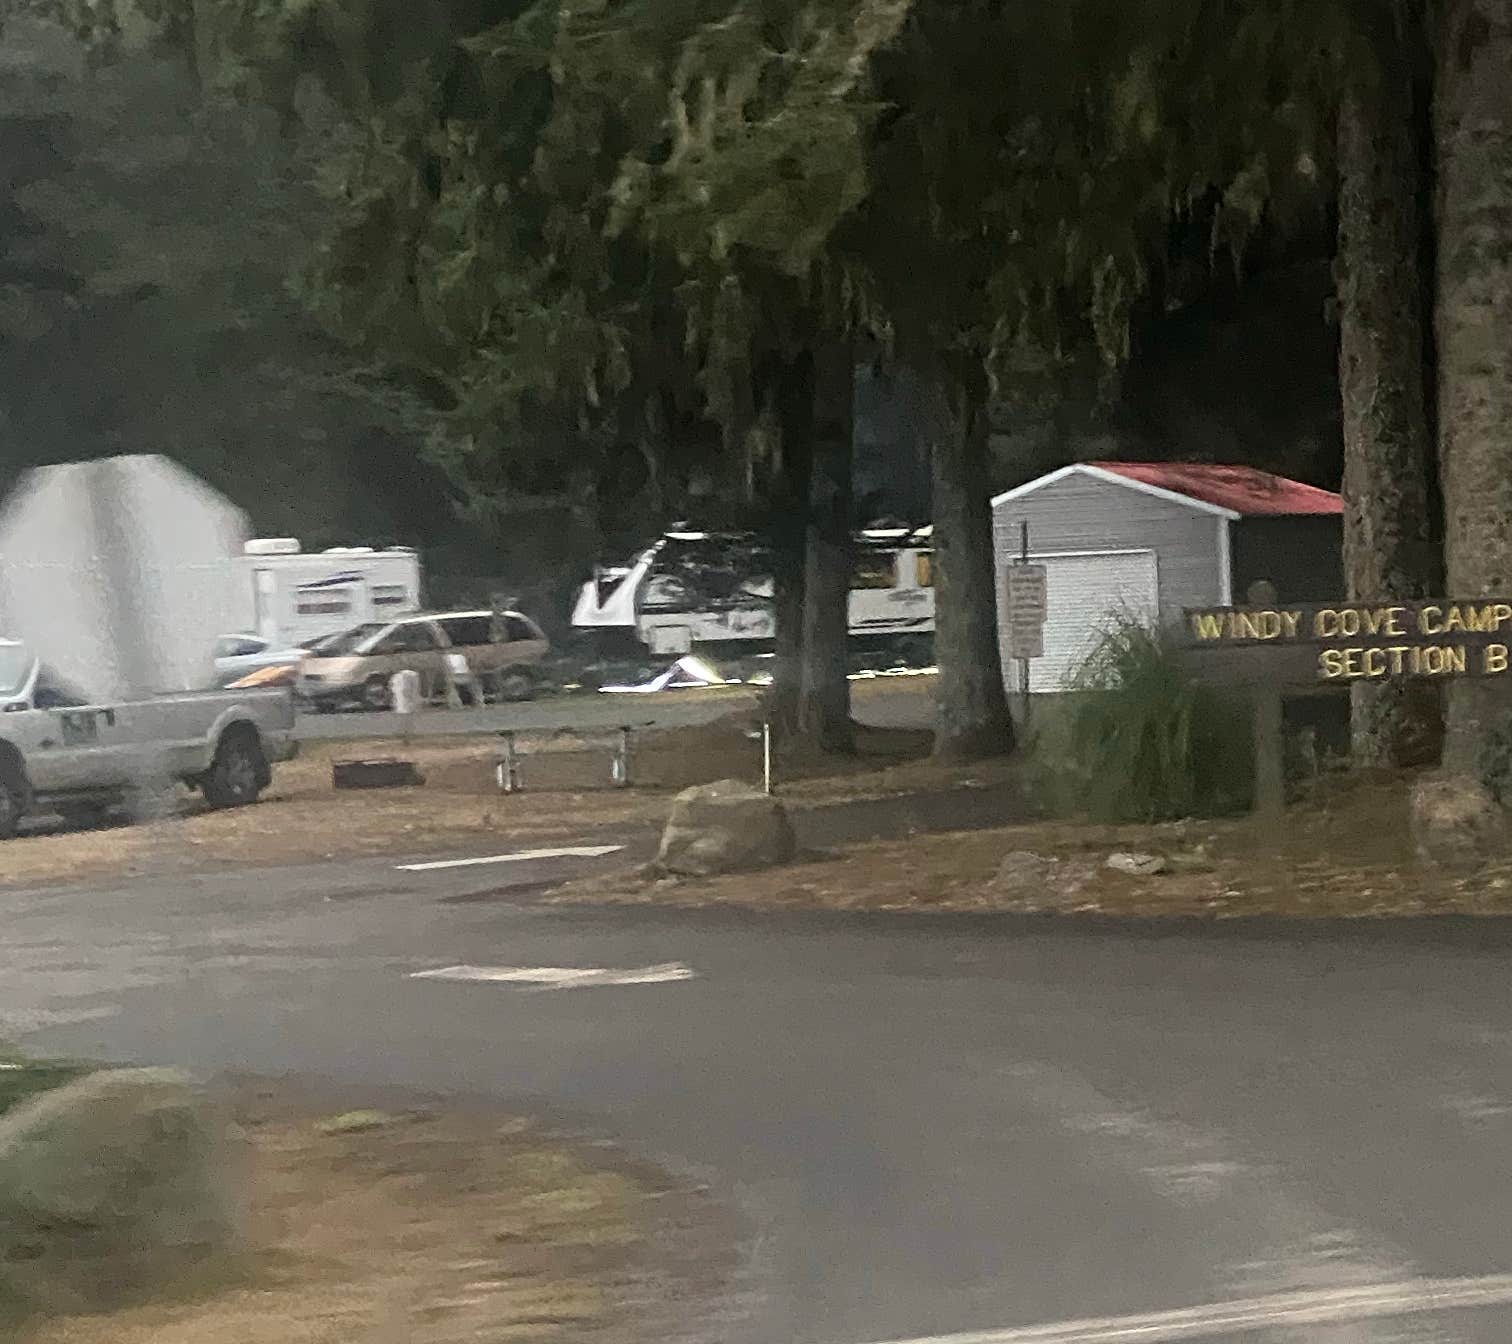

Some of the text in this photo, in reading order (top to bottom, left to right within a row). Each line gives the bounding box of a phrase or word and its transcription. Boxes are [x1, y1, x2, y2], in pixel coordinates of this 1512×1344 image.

[1194, 610, 1302, 640] WINDY
[1315, 607, 1407, 638] COVE
[1318, 643, 1466, 678] SECTION
[1485, 643, 1509, 673] B
